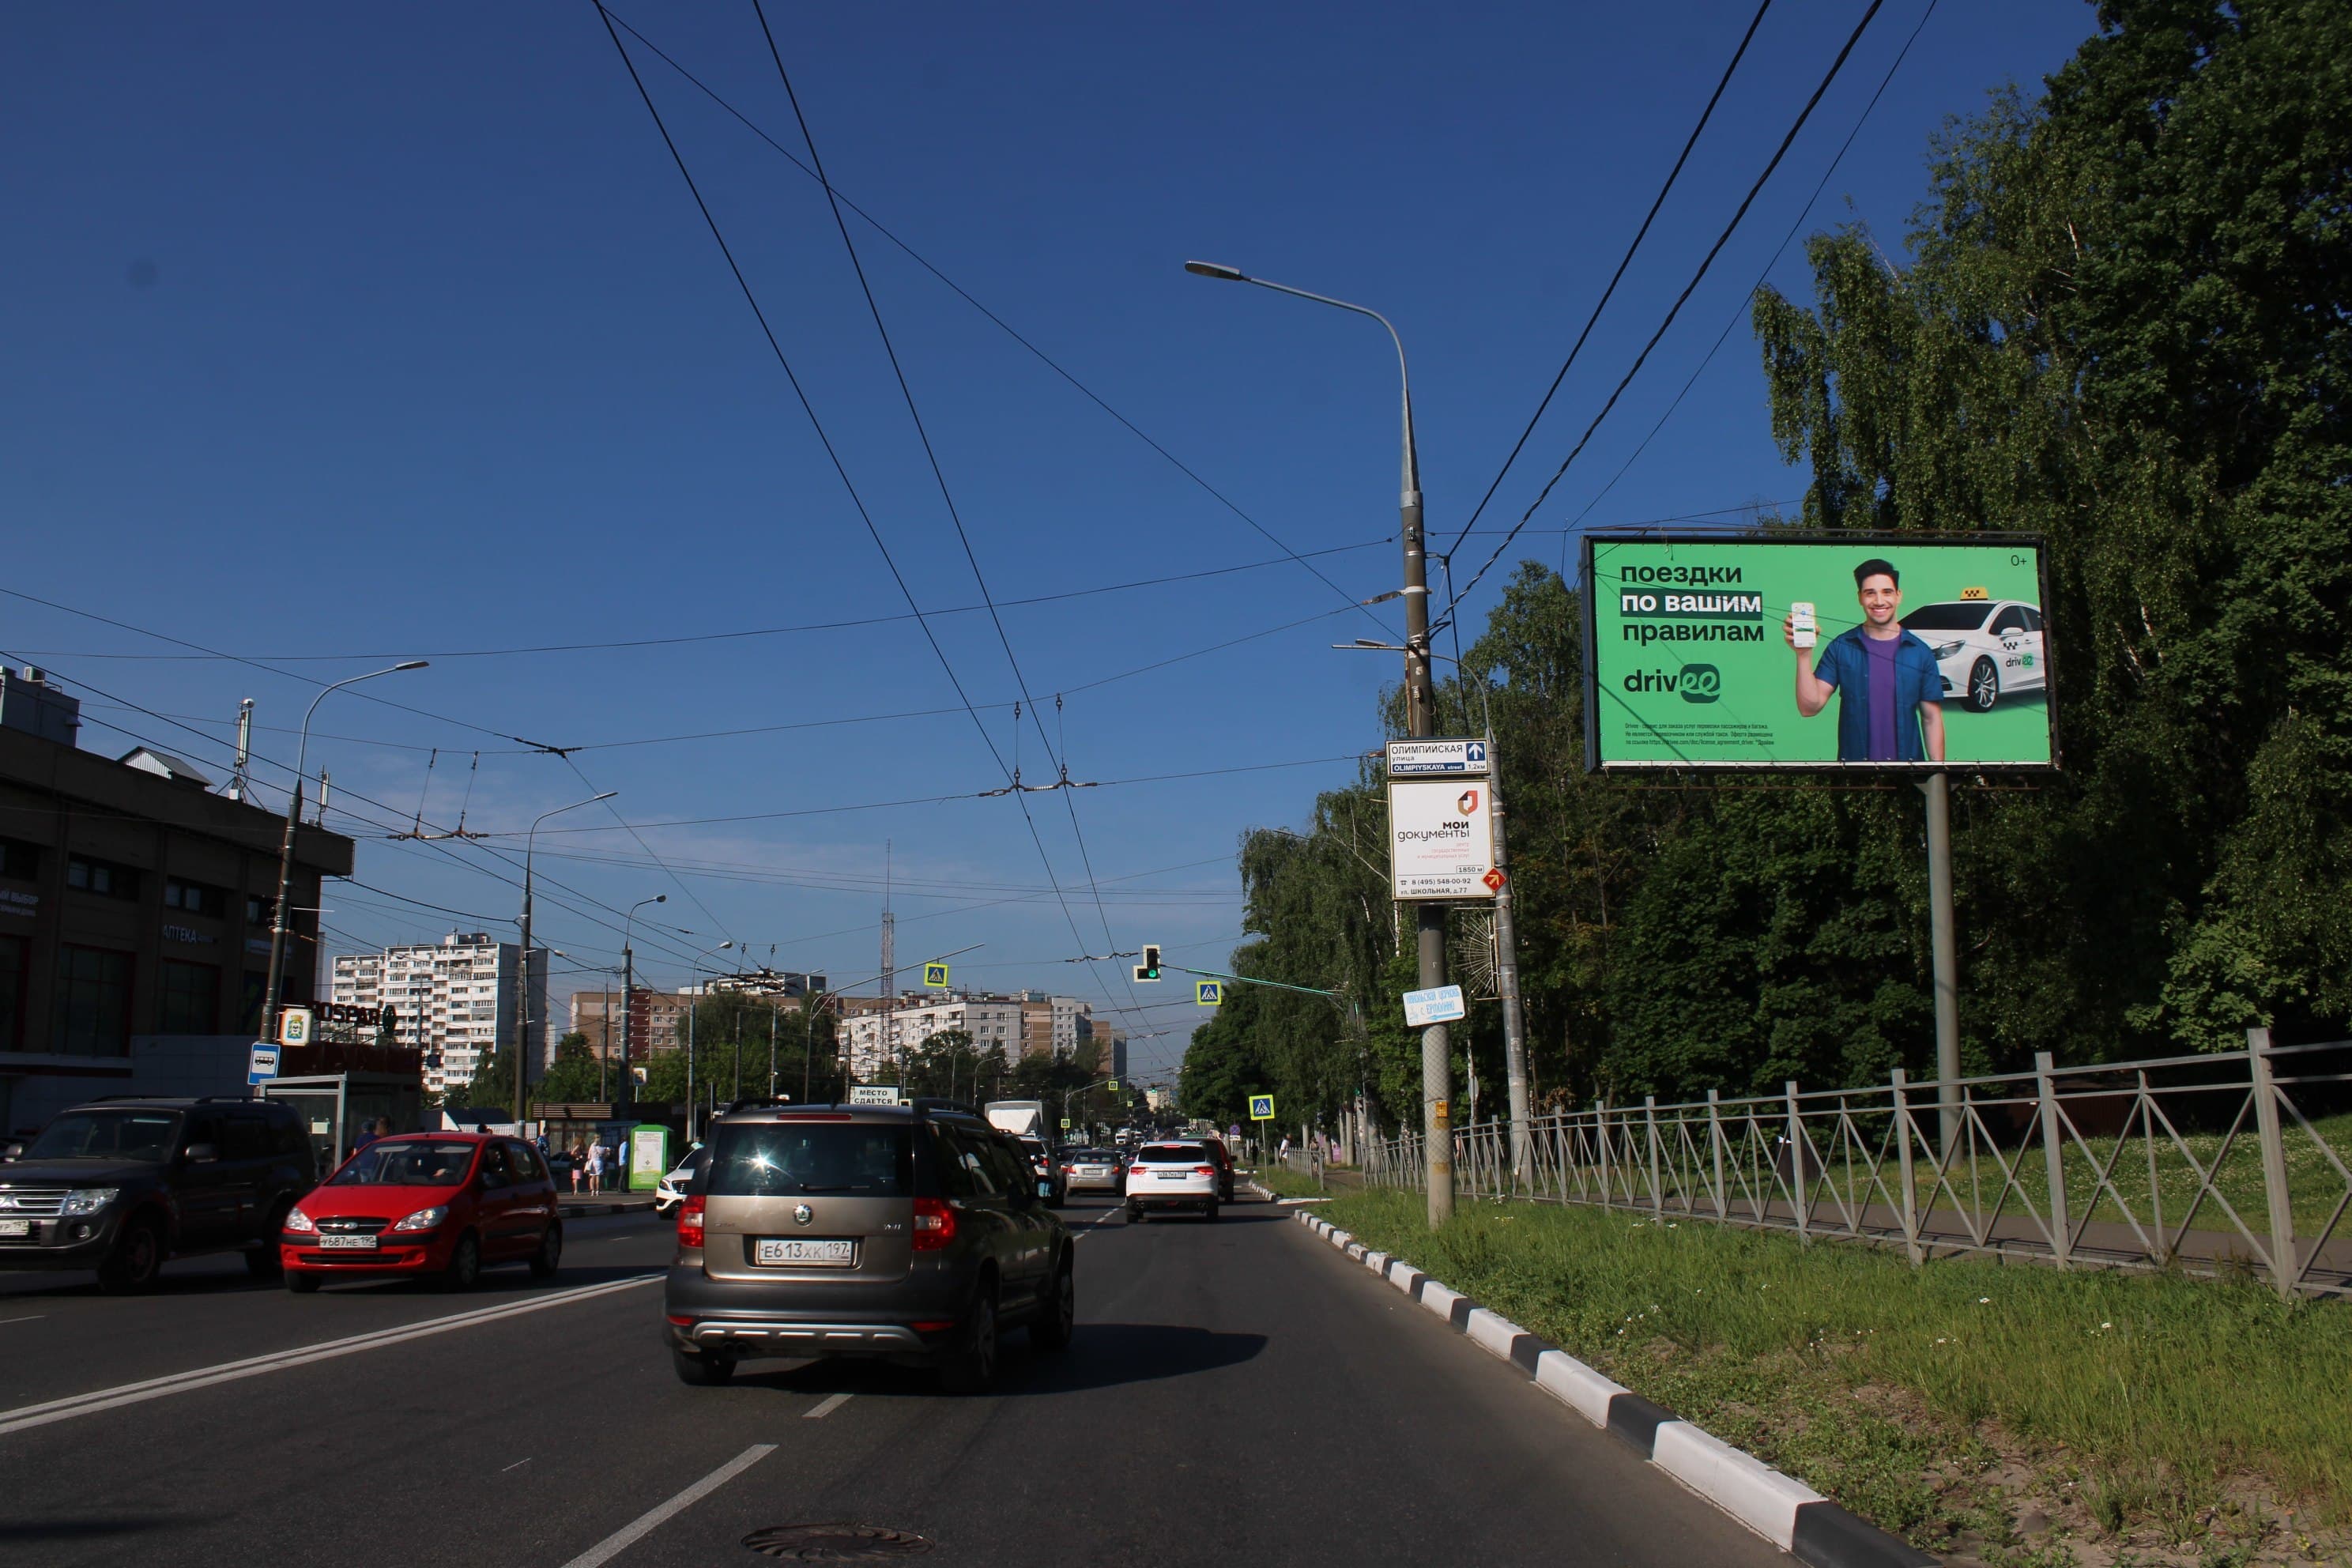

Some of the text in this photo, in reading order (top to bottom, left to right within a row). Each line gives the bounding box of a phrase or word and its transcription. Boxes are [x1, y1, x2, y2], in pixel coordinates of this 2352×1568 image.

[2011, 555, 2027, 567] 0+
[1621, 566, 1742, 586] поездки
[1622, 594, 1762, 612] по вашим
[1623, 624, 1765, 646] правилам
[1623, 668, 1721, 699] drivee
[1391, 744, 1463, 755] ОЛИМПИЙСКАЯ
[1443, 821, 1469, 830] мои
[1397, 829, 1470, 842] документы
[164, 924, 197, 944] АПТЕКА
[311, 1001, 381, 1027] ROSPAR
[827, 1242, 847, 1254] 197
